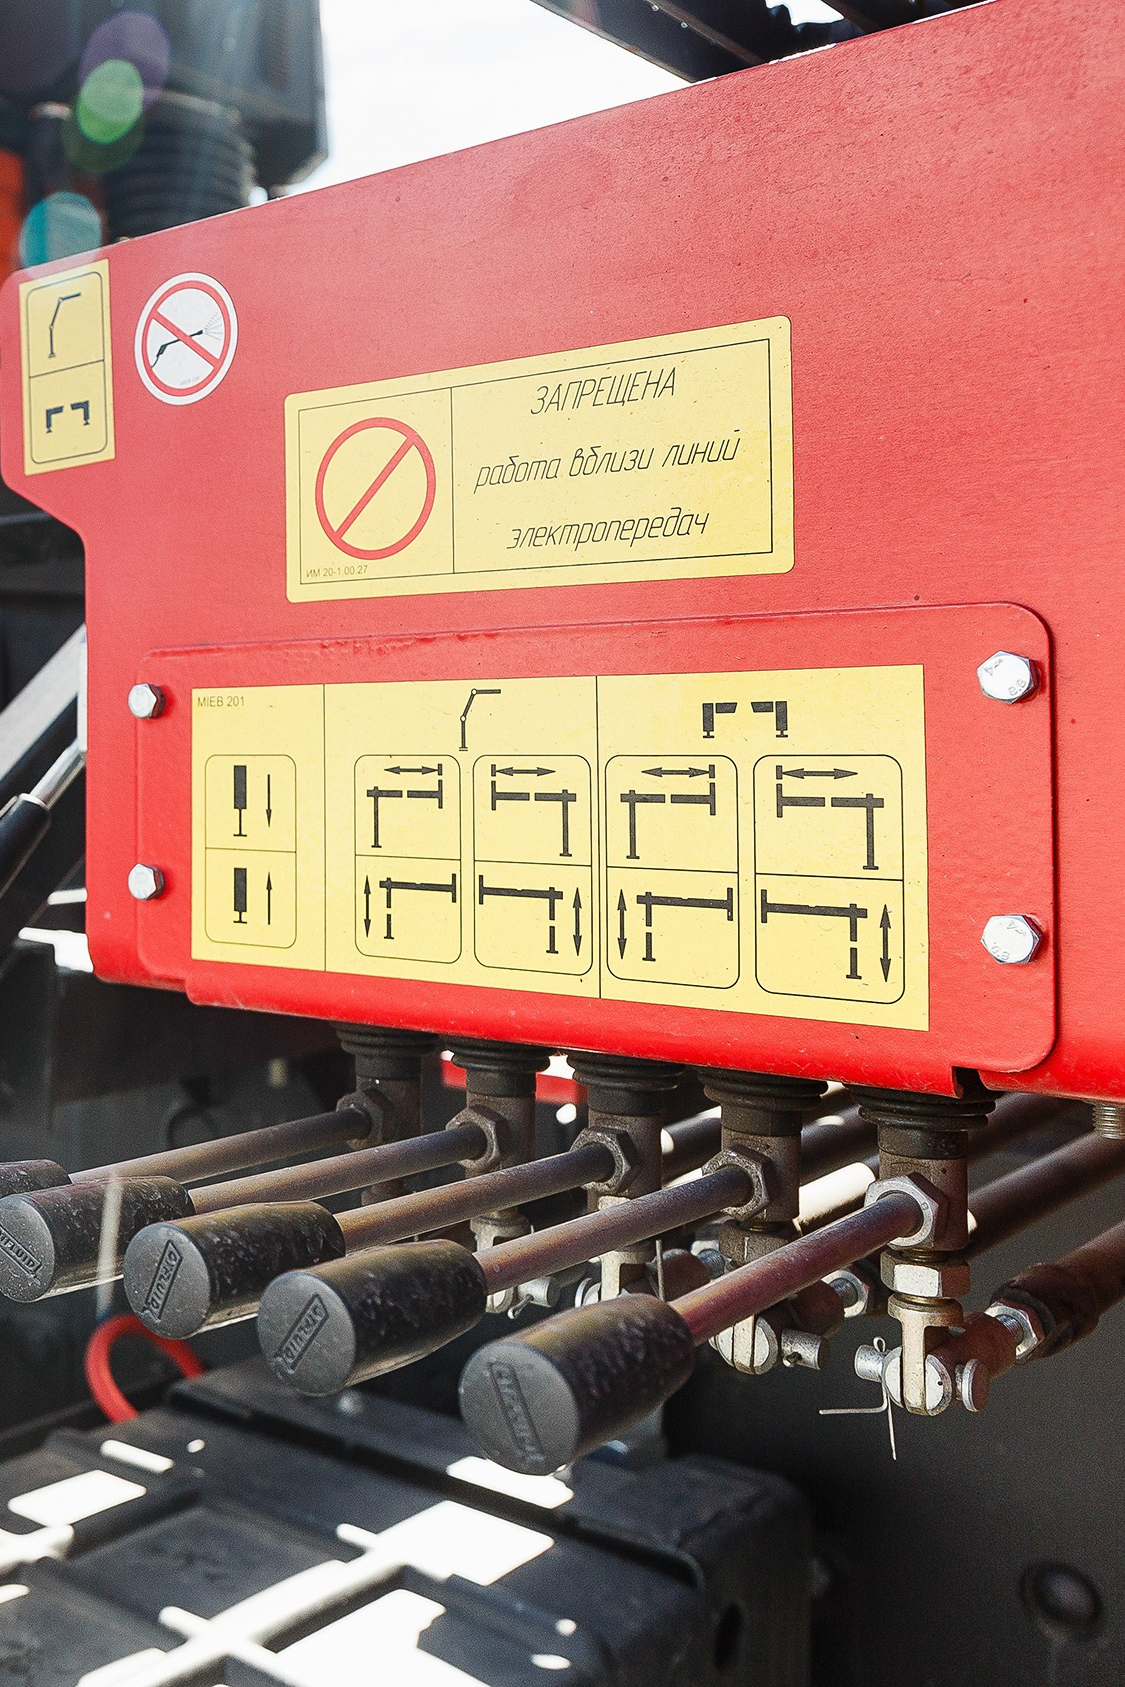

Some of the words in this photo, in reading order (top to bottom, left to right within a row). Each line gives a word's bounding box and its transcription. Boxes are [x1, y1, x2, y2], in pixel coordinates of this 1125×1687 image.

[530, 365, 676, 415] ЗАПРЕЩЕНА
[473, 455, 561, 494] работа
[568, 446, 655, 477] вблизи
[661, 429, 742, 468] линий
[506, 507, 710, 552] электропередач
[227, 695, 245, 707] 201
